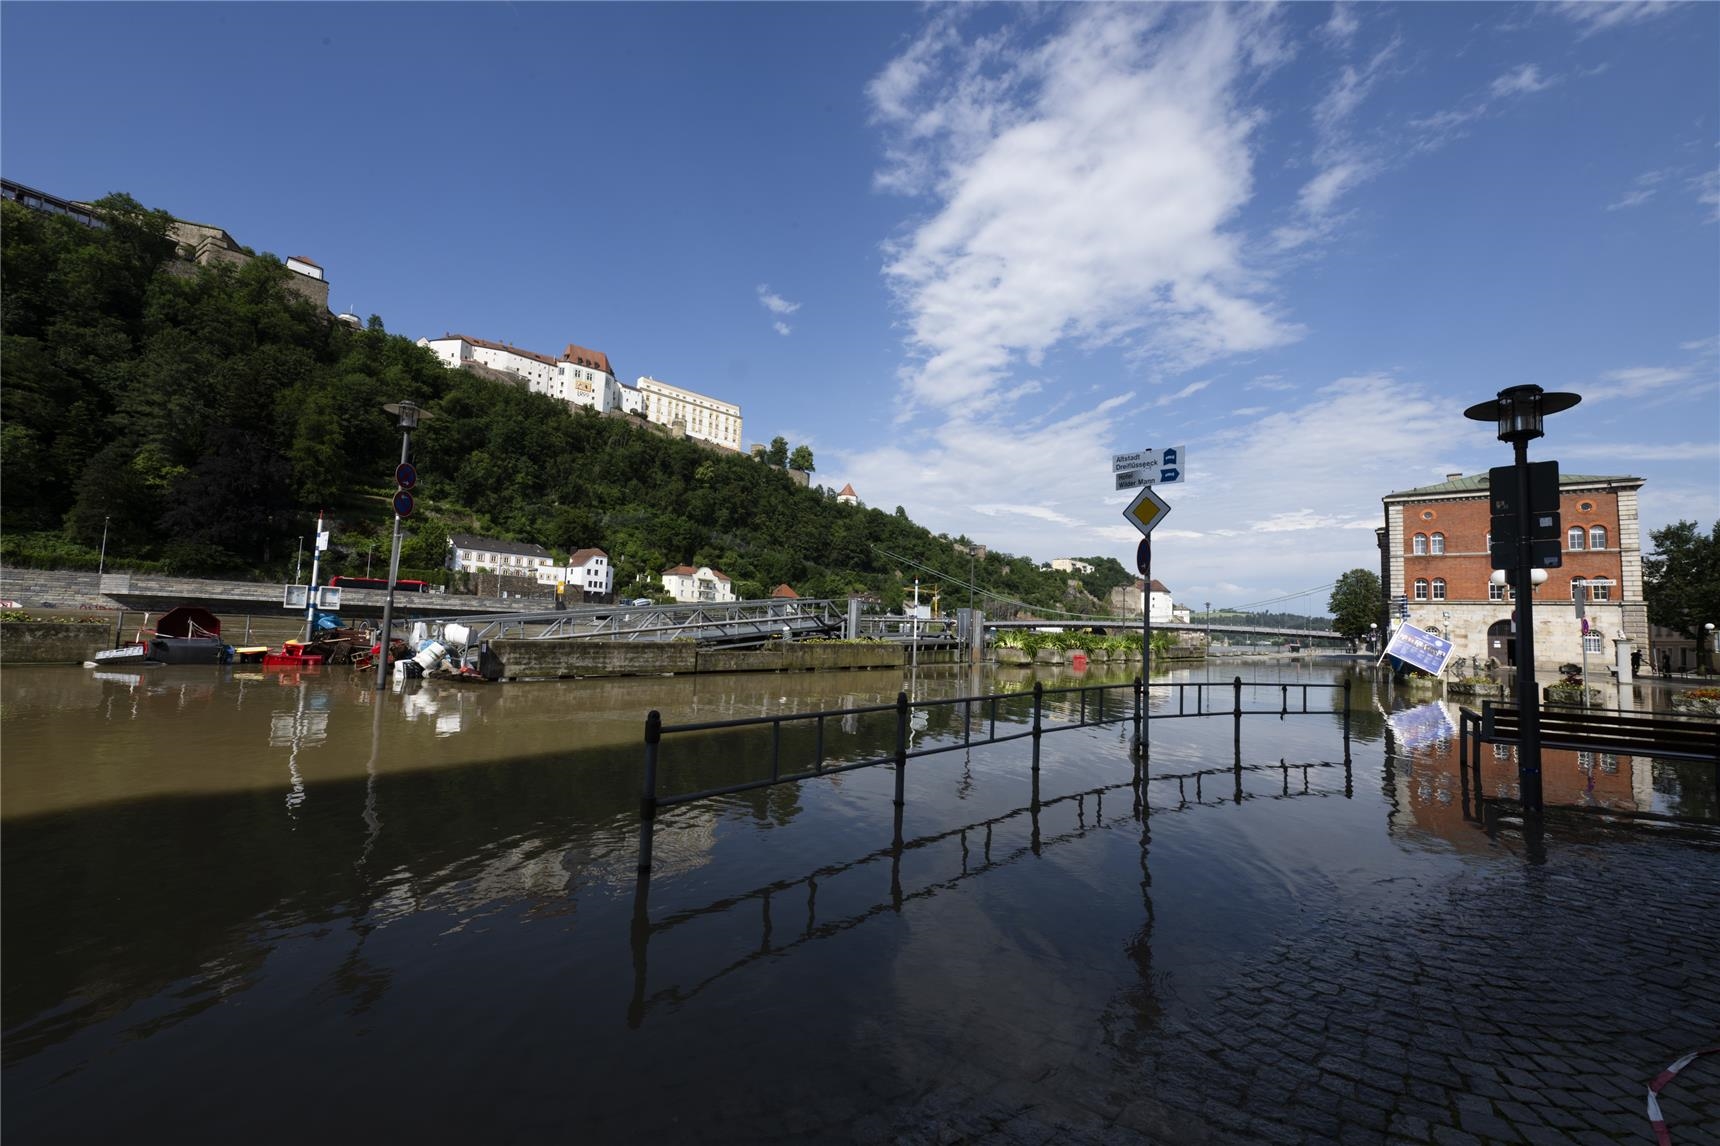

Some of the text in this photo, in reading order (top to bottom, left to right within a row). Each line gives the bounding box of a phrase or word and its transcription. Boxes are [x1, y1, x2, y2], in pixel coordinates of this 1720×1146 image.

[1116, 454, 1140, 463] Altstadt
[1116, 459, 1158, 470] Dreiflüsseeck
[1118, 480, 1136, 488] Wilder
